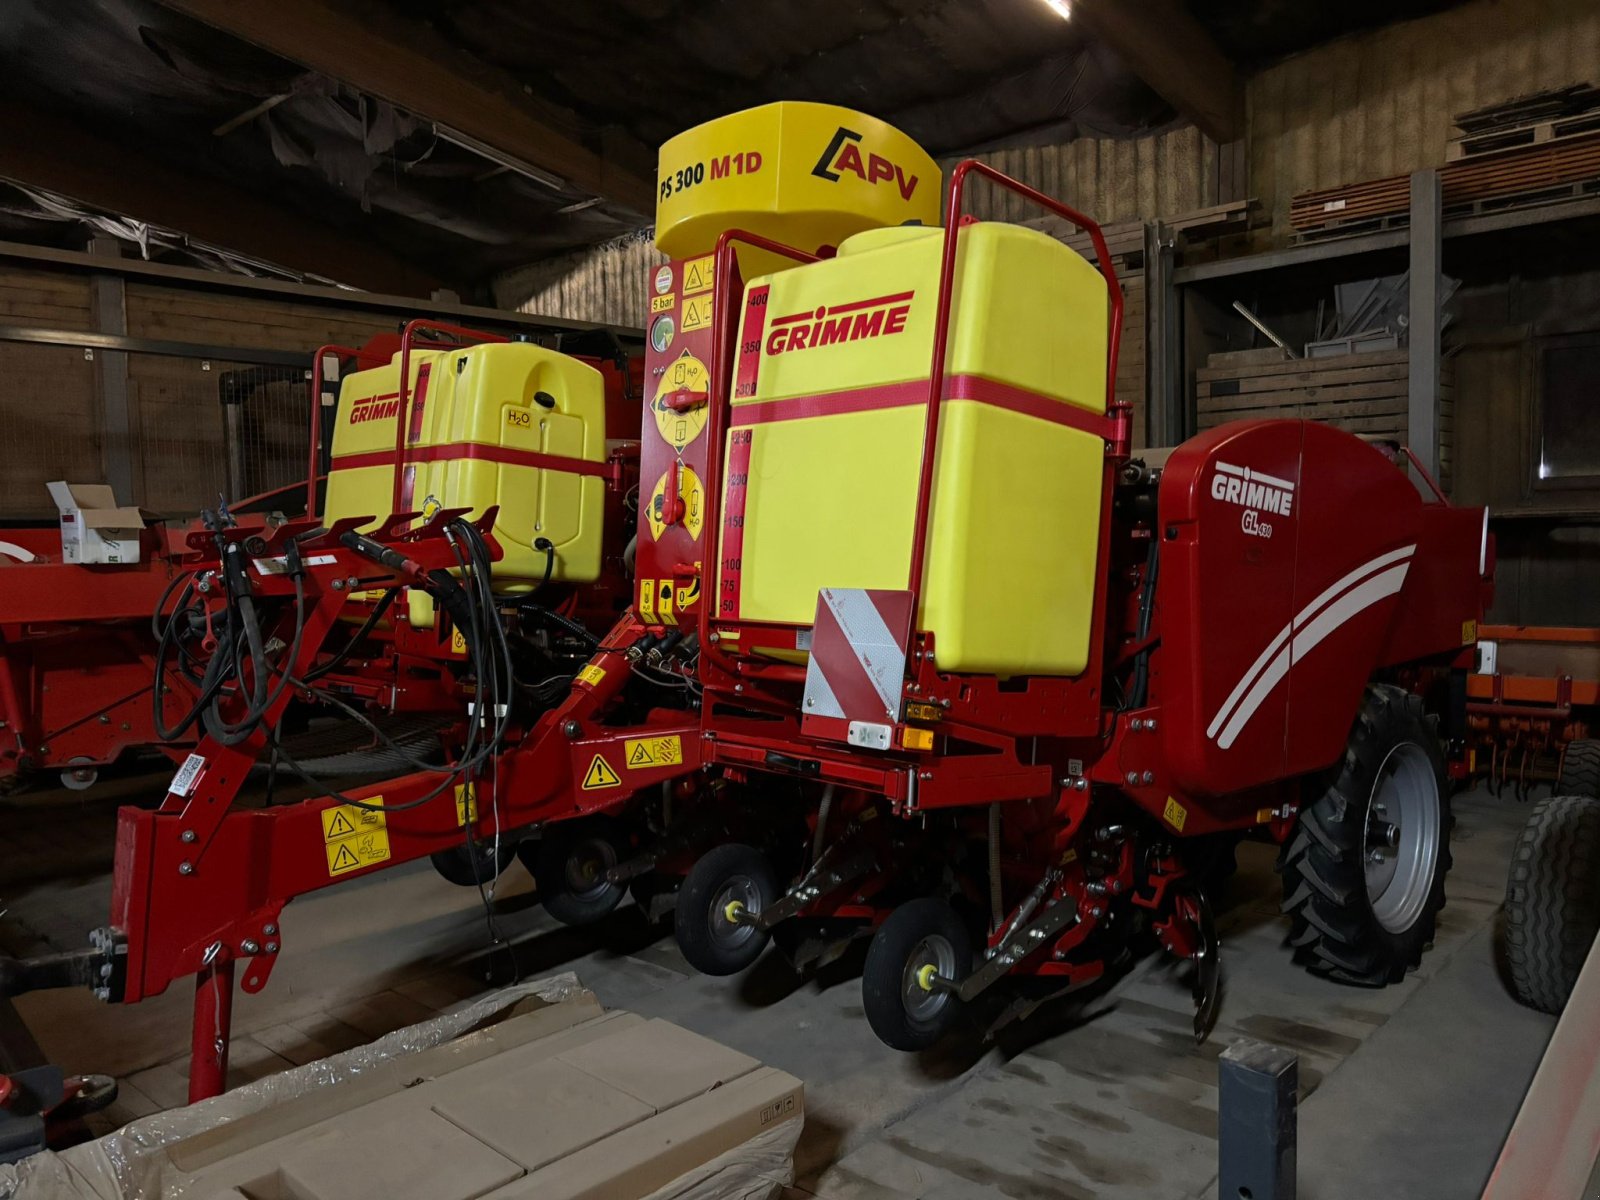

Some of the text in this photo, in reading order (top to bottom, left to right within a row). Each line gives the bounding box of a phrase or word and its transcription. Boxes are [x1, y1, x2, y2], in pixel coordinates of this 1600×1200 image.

[660, 151, 762, 203] PS 300 M1D
[833, 142, 919, 202] APV
[653, 297, 672, 310] 5 bar
[751, 293, 768, 306] 400
[766, 291, 914, 355] GRIMME
[744, 341, 760, 354] 350
[739, 382, 756, 395] 300
[350, 390, 409, 424] GRIMM
[731, 474, 747, 487] 200
[1211, 460, 1295, 517] GRIMME
[728, 516, 743, 528] 150
[1243, 511, 1272, 537] GL 430
[725, 559, 741, 571] 100
[724, 580, 735, 592] 75
[723, 600, 734, 612] 50
